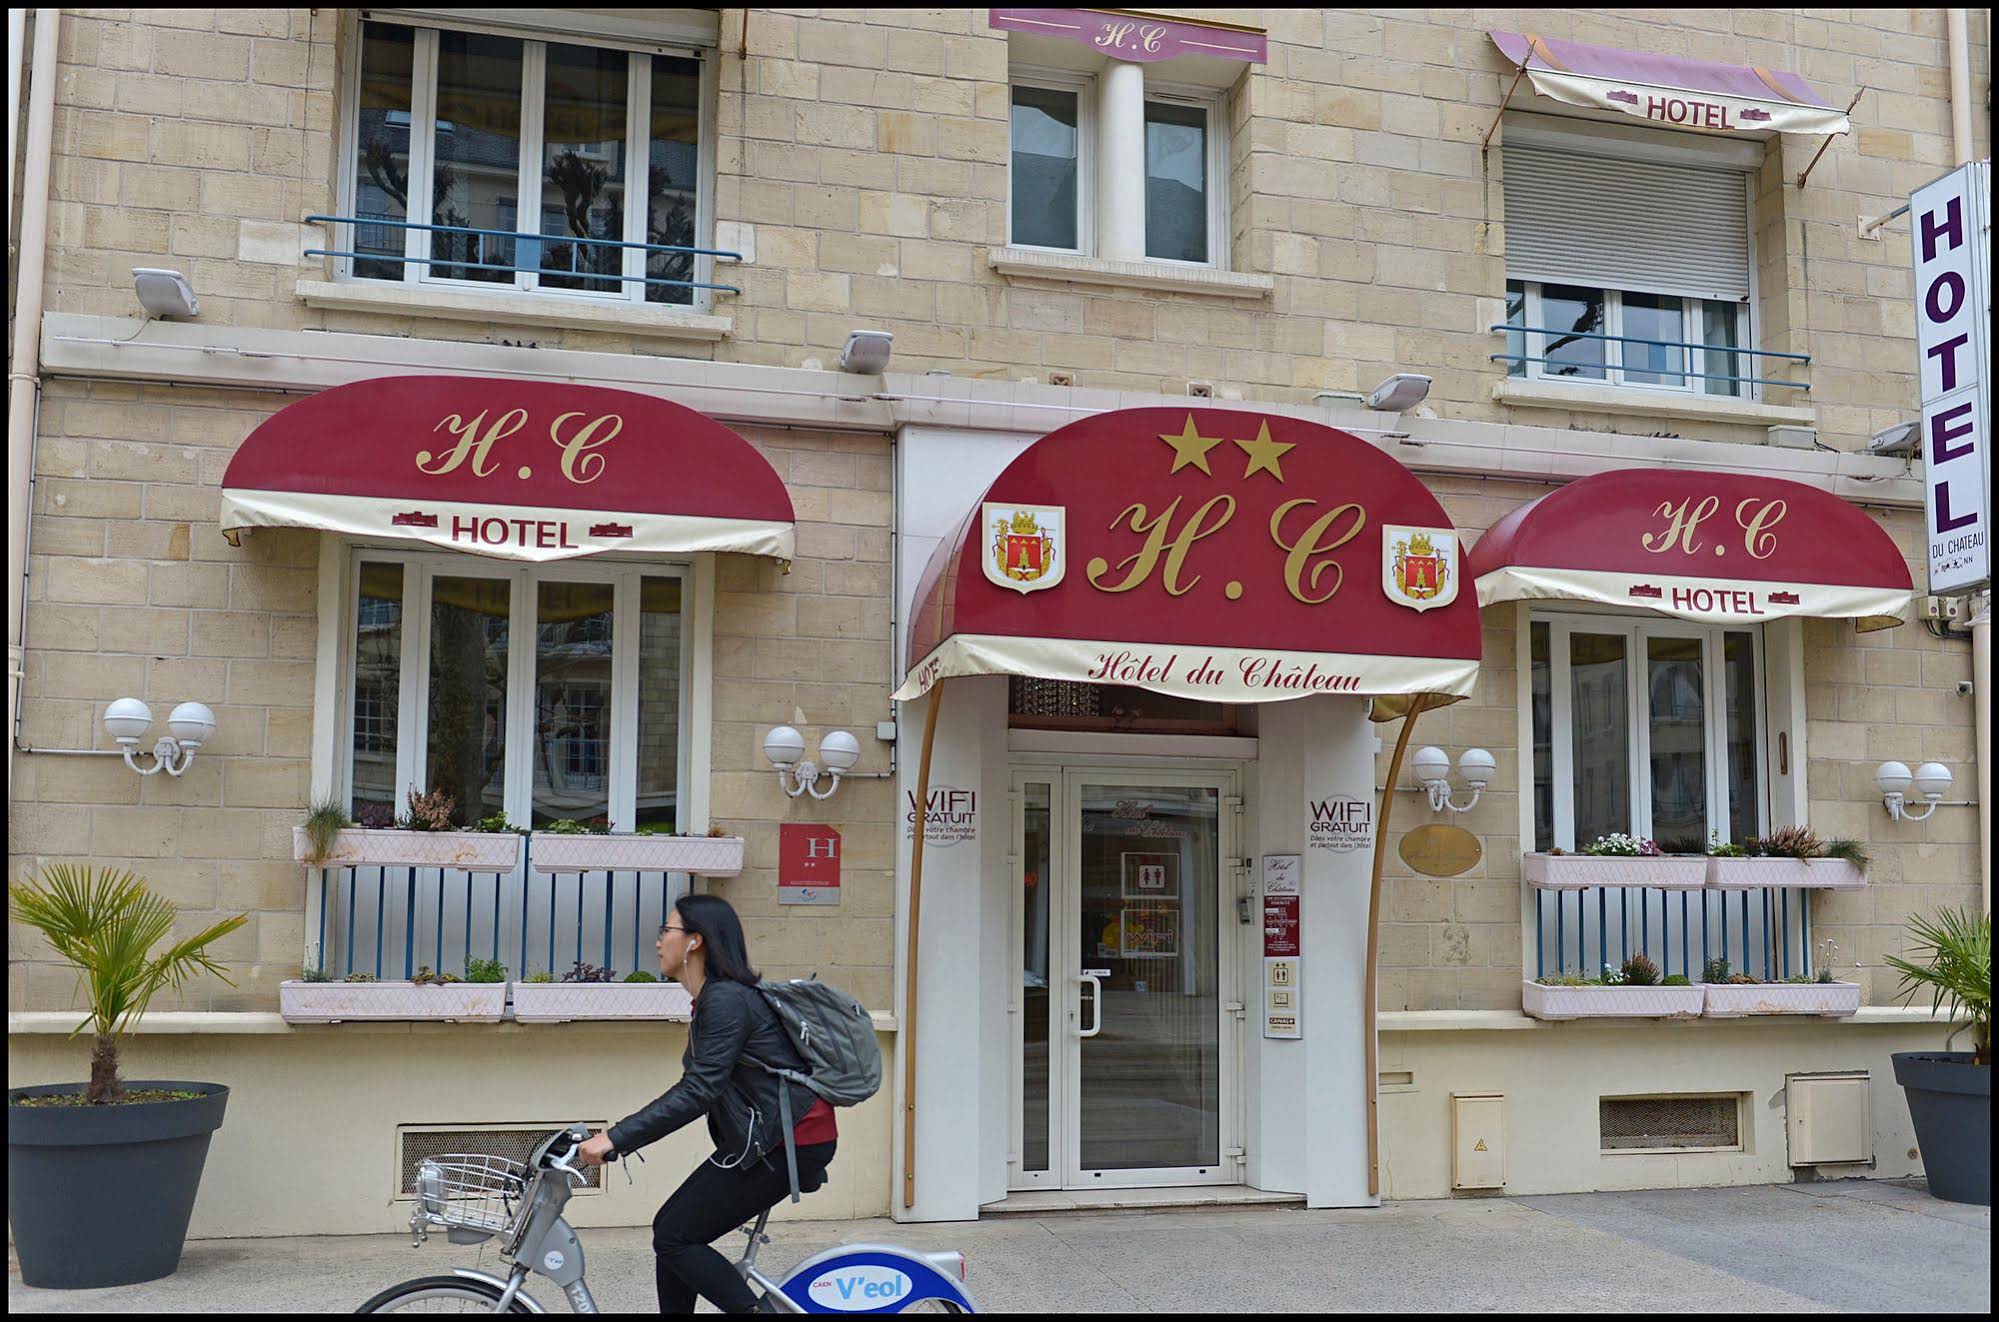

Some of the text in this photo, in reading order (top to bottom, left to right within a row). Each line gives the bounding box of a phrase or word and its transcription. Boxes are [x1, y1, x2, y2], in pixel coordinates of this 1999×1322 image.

[1646, 95, 1736, 130] HOTEL
[1919, 195, 1978, 535] HOTEL
[452, 515, 580, 549] HOTEL
[1932, 531, 1984, 559] DU CHATEAU
[1672, 587, 1765, 615] HOTEL
[1088, 650, 1362, 692] Hôtel du Château
[907, 790, 976, 812] WIFI
[1310, 801, 1371, 822] WIFI
[1310, 822, 1371, 833] GRATUIT
[1345, 834, 1371, 842] chambre
[806, 837, 839, 858] H
[836, 1274, 902, 1300] V'eol
